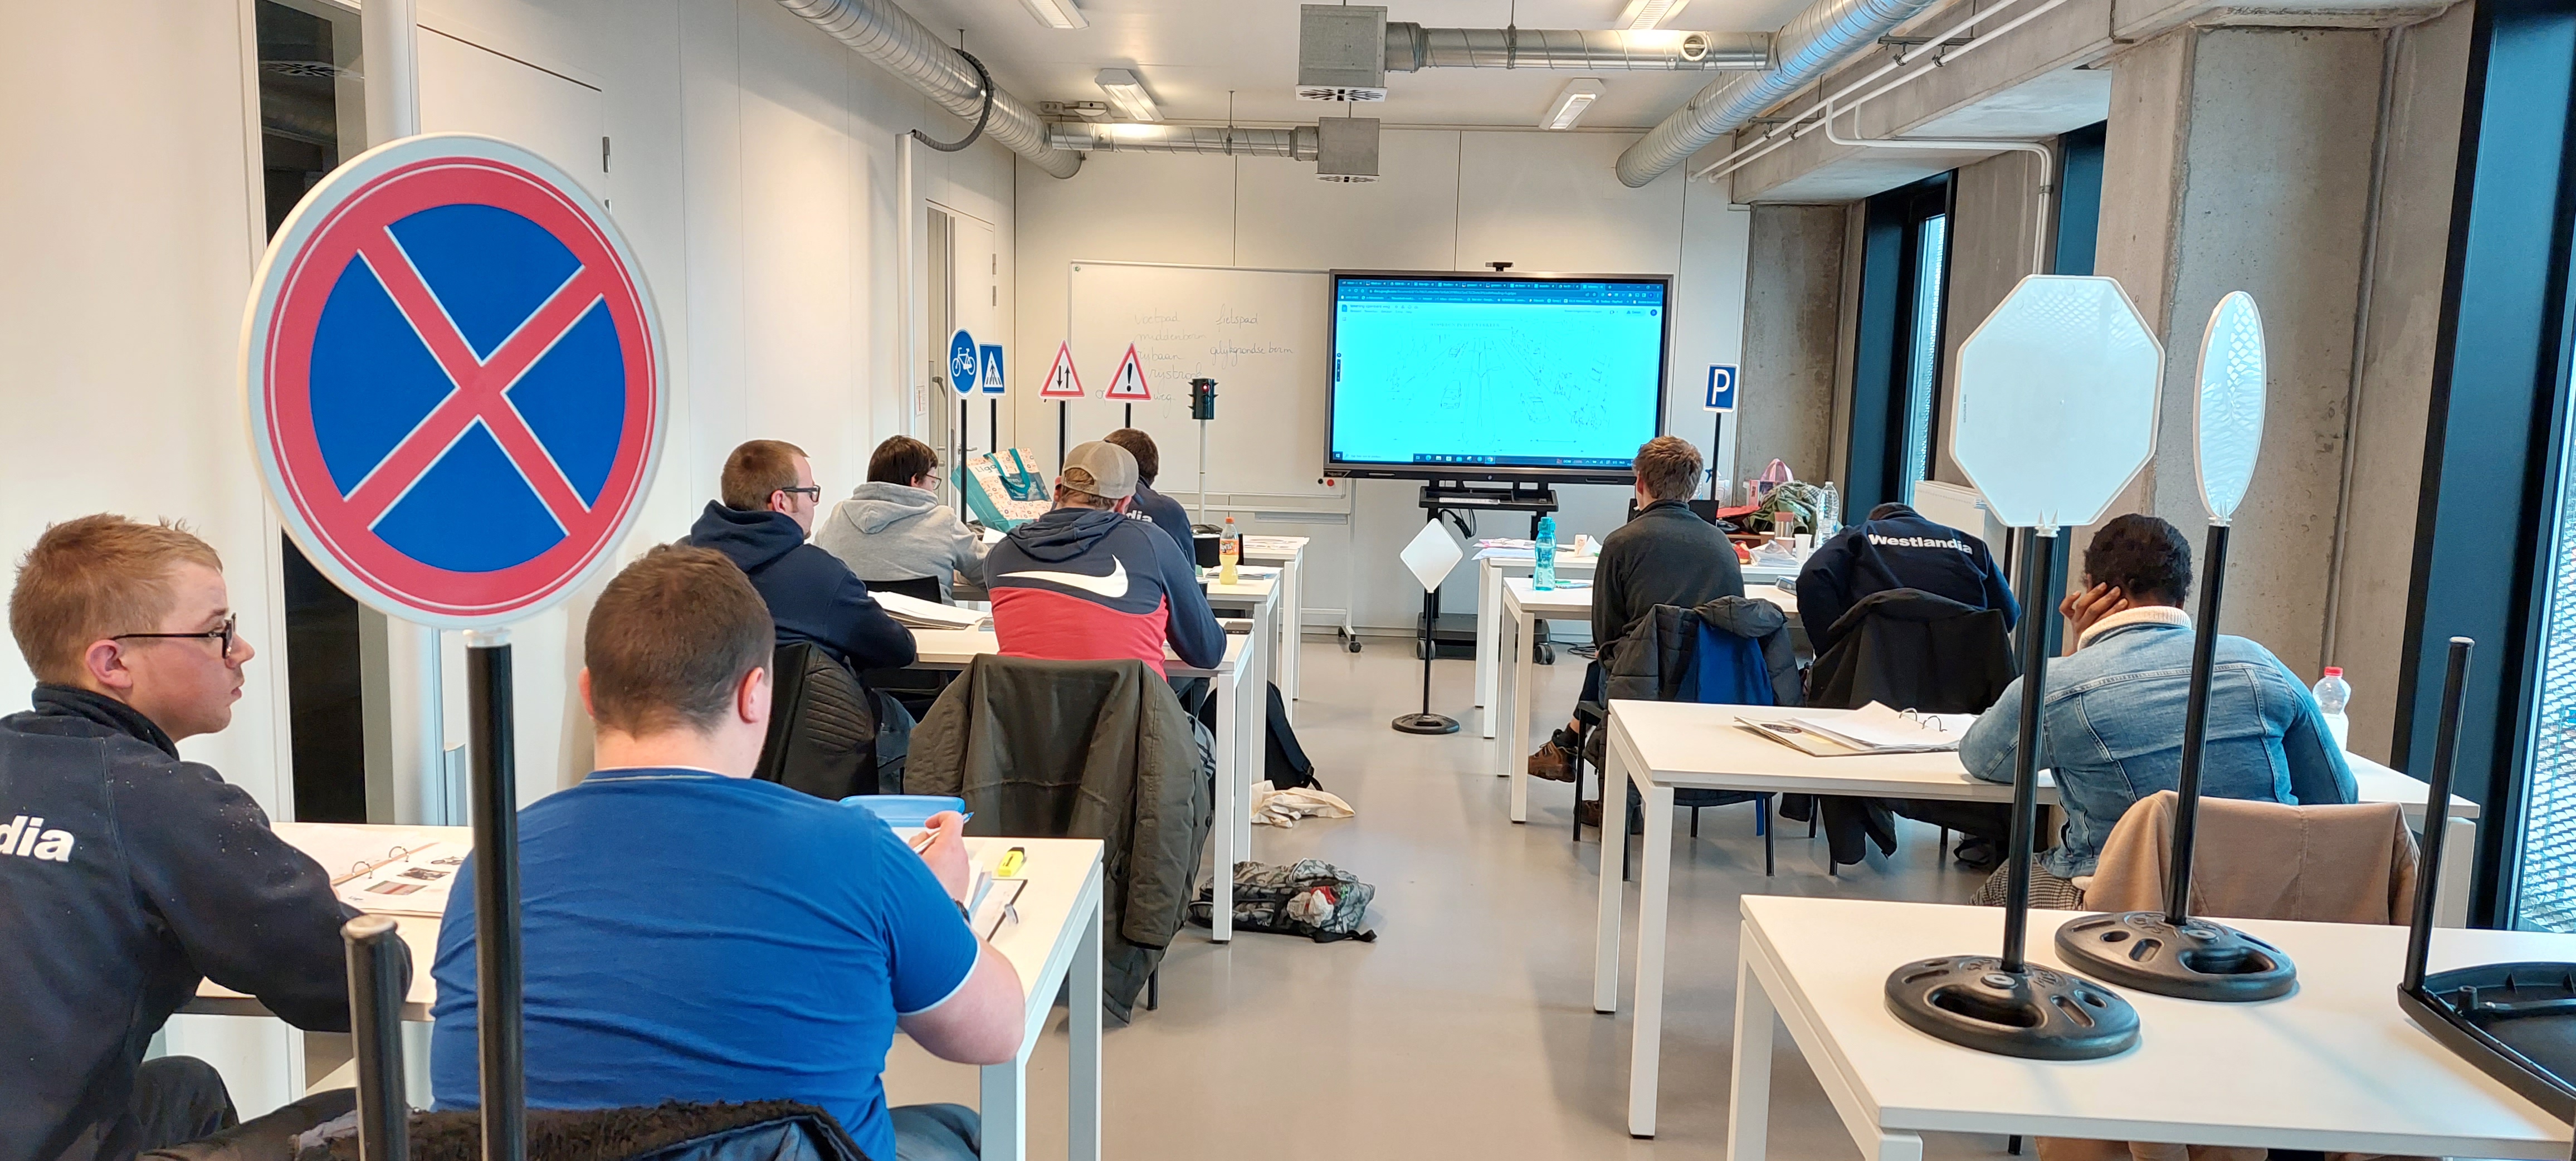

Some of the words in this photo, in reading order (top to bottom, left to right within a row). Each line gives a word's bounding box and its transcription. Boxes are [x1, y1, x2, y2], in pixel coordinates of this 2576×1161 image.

[1216, 304, 1258, 332] fietspad
[1711, 369, 1730, 405] P
[1868, 534, 1973, 555] Westlandia
[0, 815, 74, 863] dia
